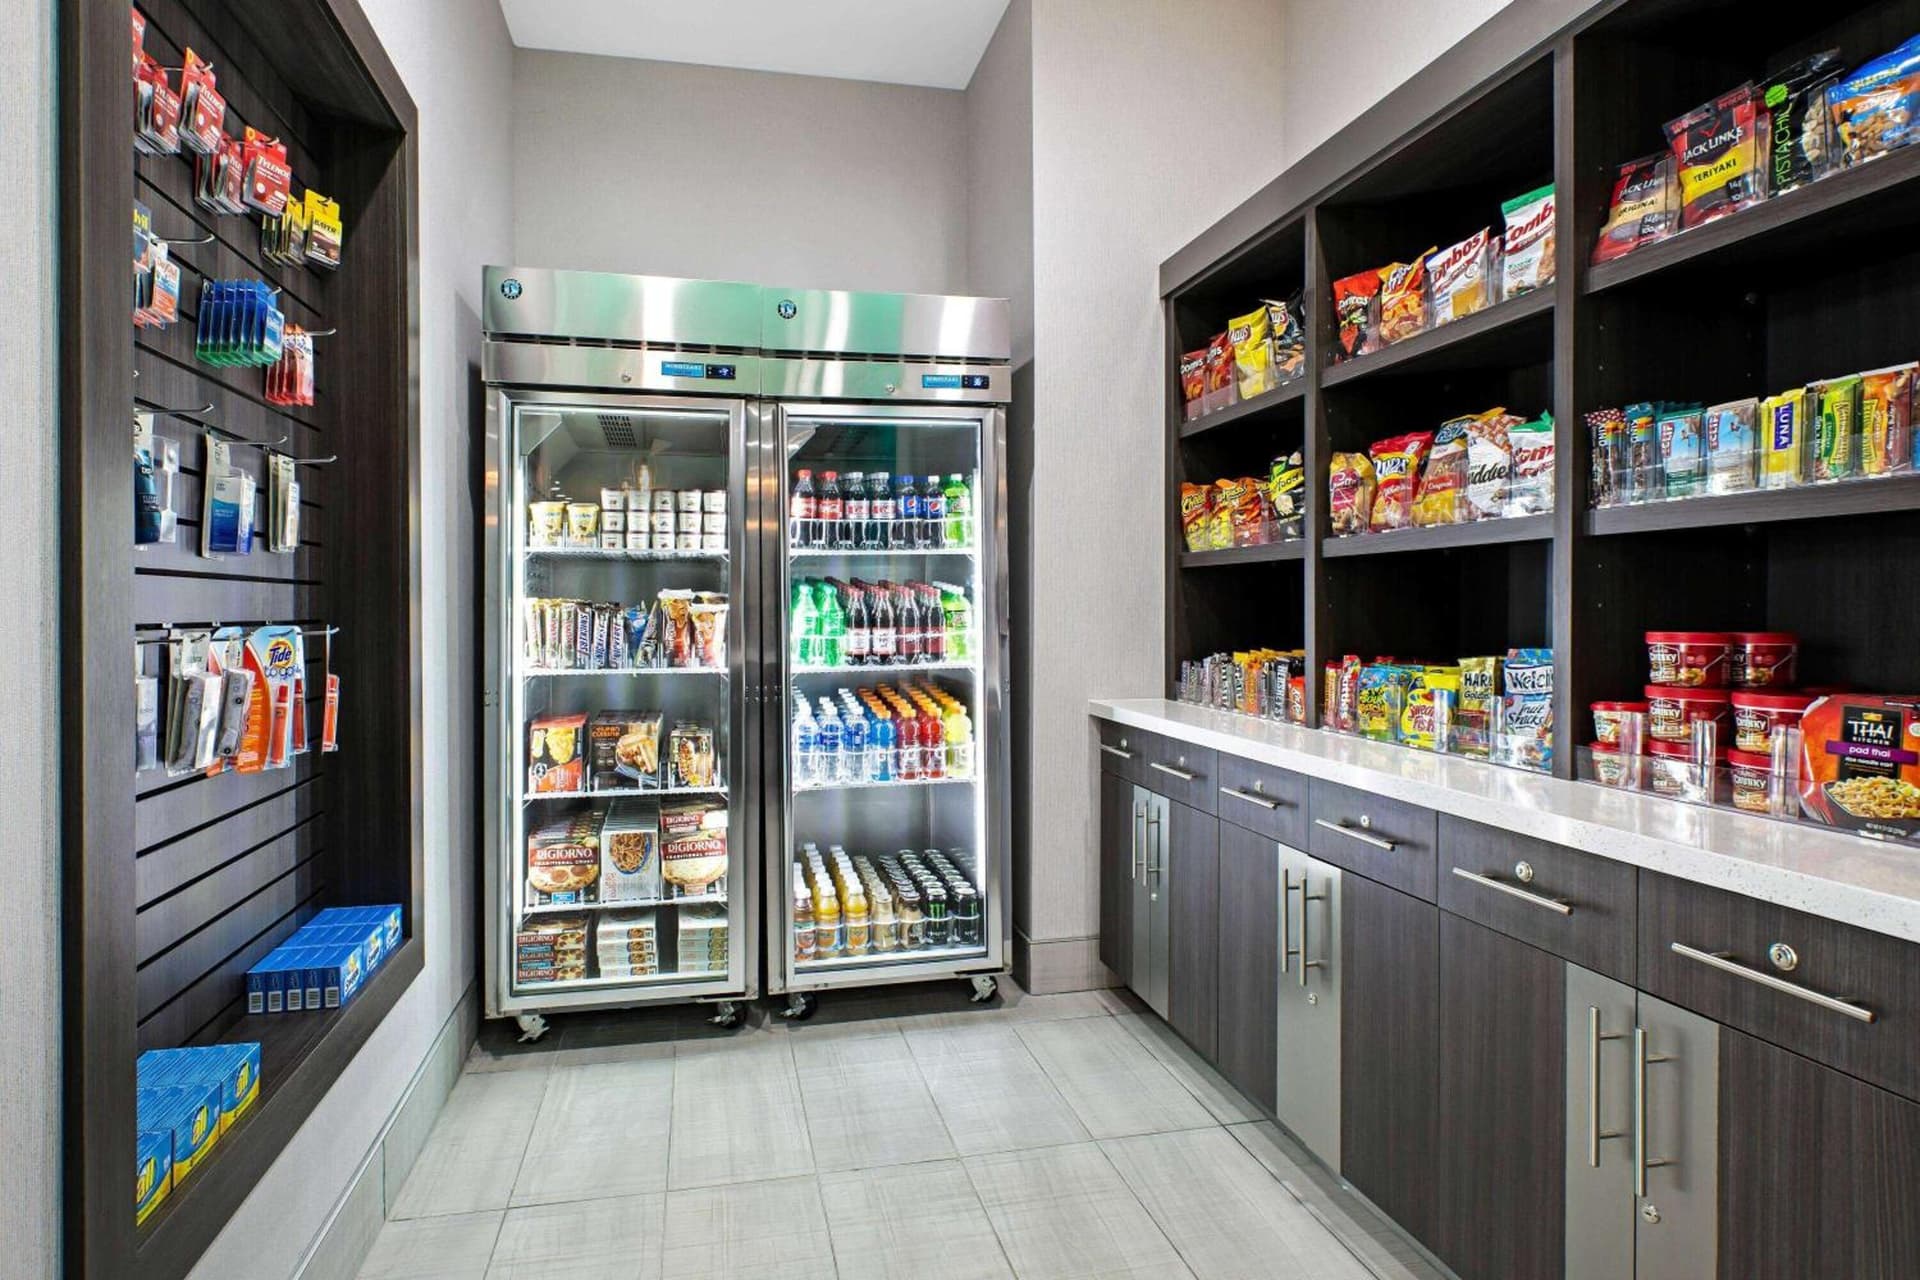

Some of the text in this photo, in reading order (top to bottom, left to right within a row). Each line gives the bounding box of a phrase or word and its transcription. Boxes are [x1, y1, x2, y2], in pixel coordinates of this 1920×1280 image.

[1683, 143, 1709, 164] JACK
[1694, 158, 1737, 183] TERIYAKI
[1779, 405, 1790, 446] LUNA
[269, 646, 292, 667] Tide
[1848, 719, 1894, 740] THAI
[1852, 736, 1890, 745] KITCHEN
[1849, 745, 1891, 759] pad thai
[535, 848, 594, 860] DIGIORNO
[668, 839, 721, 853] DIGIORNO
